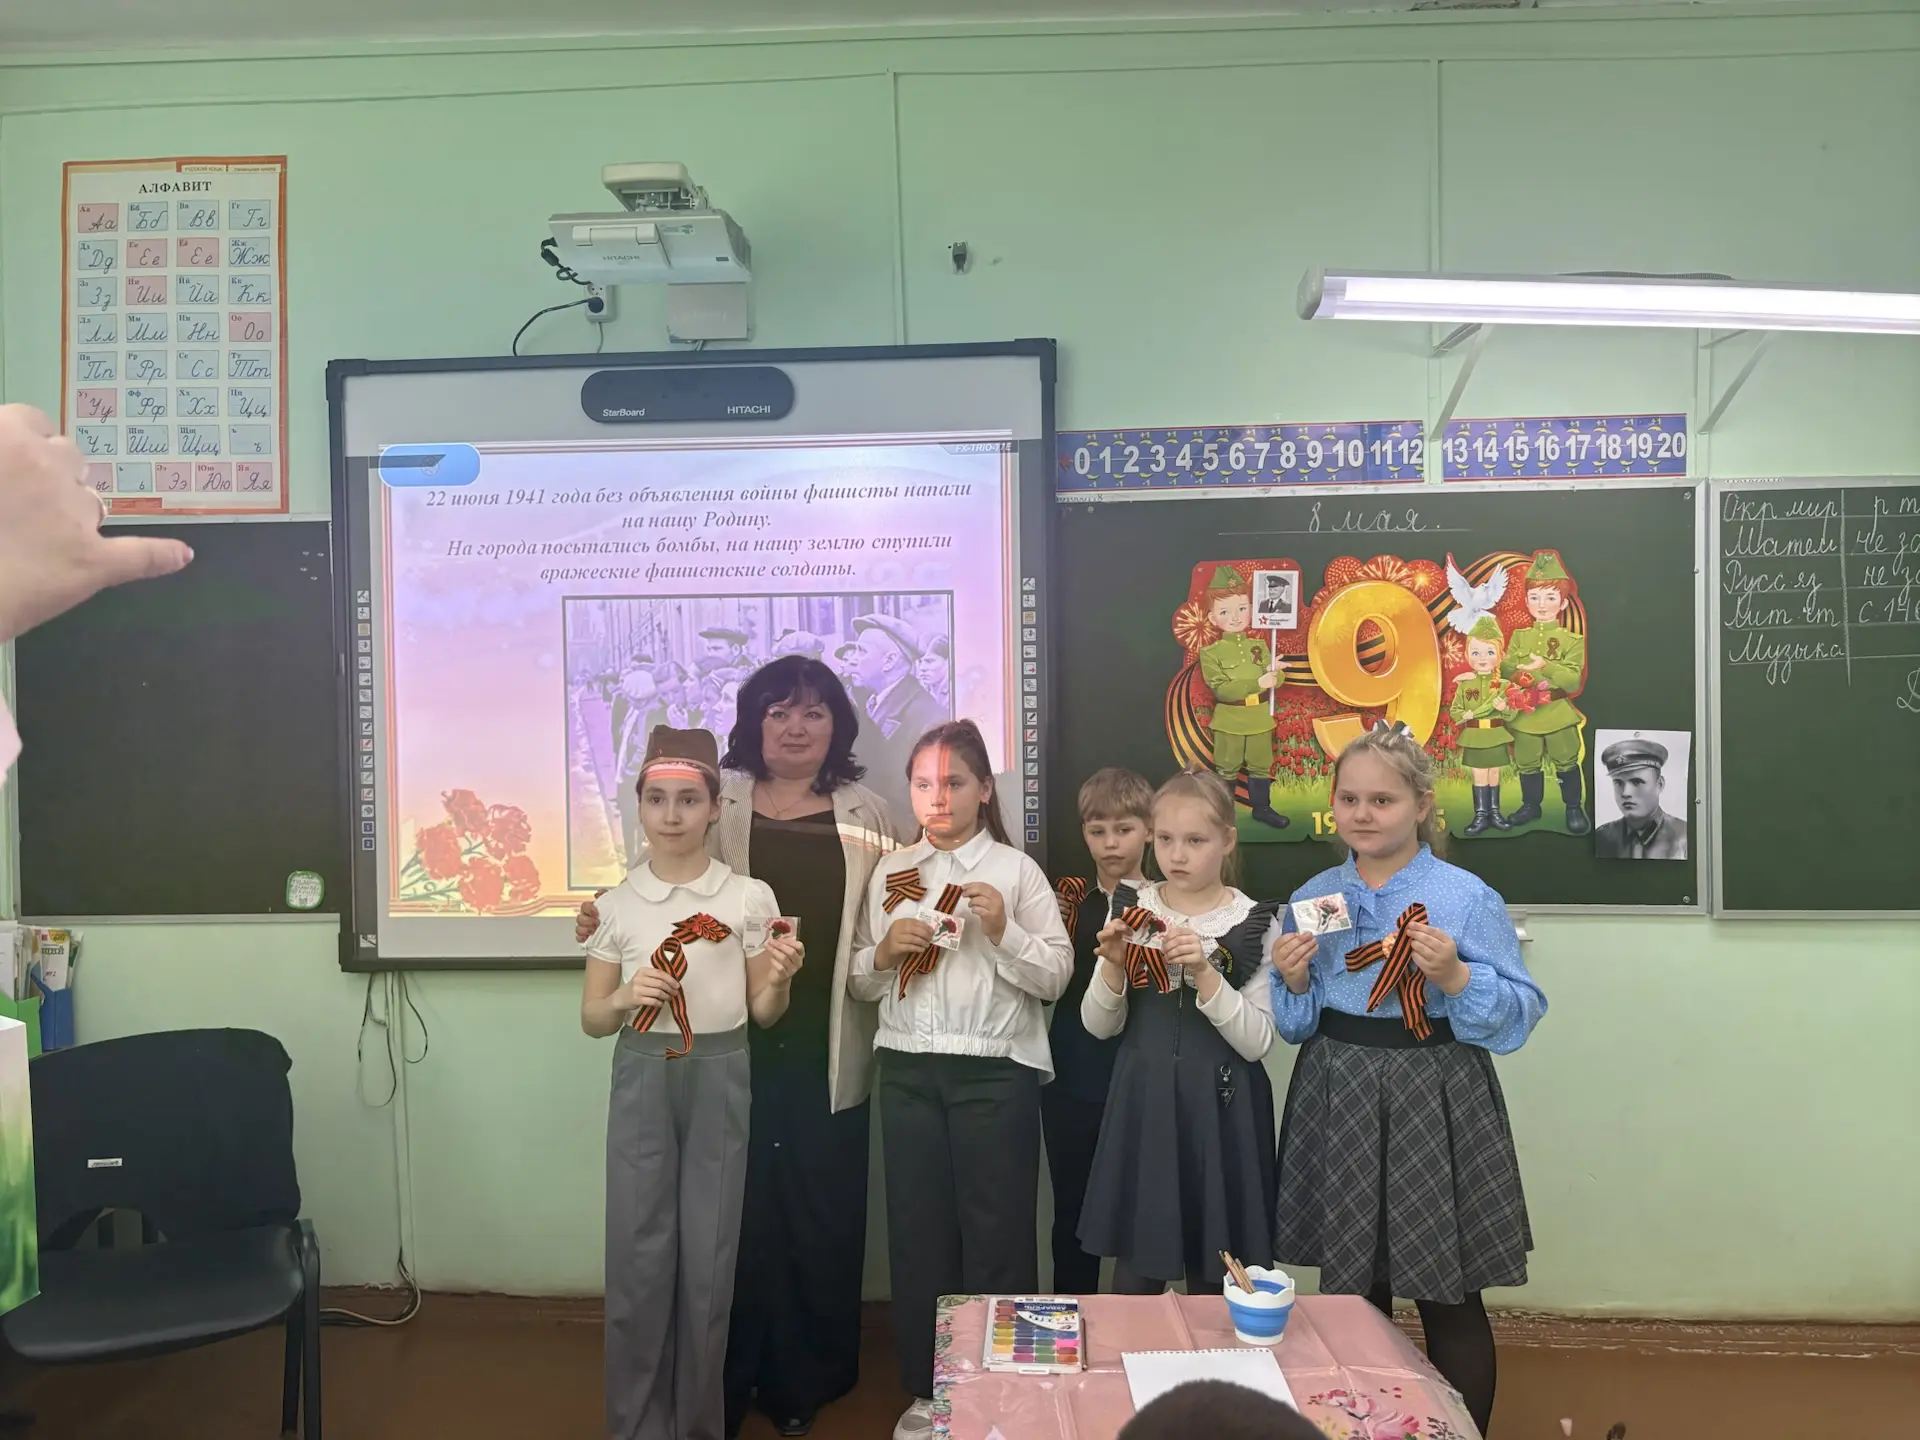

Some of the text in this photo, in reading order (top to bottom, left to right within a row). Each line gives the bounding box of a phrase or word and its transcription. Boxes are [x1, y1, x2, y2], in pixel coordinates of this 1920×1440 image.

[139, 181, 212, 193] АЛФАВИТ
[89, 209, 266, 230] Аа Бб Вв Гг
[139, 248, 159, 265] Ее
[230, 247, 268, 264] Жж
[137, 286, 164, 303] Ии
[188, 283, 217, 303] Йй
[237, 284, 271, 303] Кк
[86, 322, 263, 341] Лл Мм Нн Оо
[84, 361, 114, 378] Пп
[137, 360, 165, 385] Рр
[229, 360, 270, 377] Тт
[90, 397, 266, 423] Уу Фф Хх Цц
[603, 408, 645, 417] StarBoard
[727, 405, 771, 414] HITACHI
[130, 435, 168, 453] Шш
[182, 435, 220, 455] Щщ
[1443, 432, 1686, 463] 13 14 15 16 17 18 19 20
[1074, 439, 1423, 475] 0 1 2 3 4 5 6 7 8 9 10 11 12
[169, 472, 187, 490] Ээ
[203, 472, 230, 490] Юю
[244, 472, 271, 490] Яя
[426, 483, 971, 506] 22 июня 1941 года без объявления войны фашисты напали
[622, 511, 771, 531] на нашу Родину.
[1309, 501, 1321, 532] 8
[447, 535, 952, 559] На города посыпались бомбы, на нашу землю ступили
[540, 561, 856, 584] вражеские фашистские солдаты.
[1729, 631, 1845, 684] Музыка
[1307, 579, 1442, 762] 9
